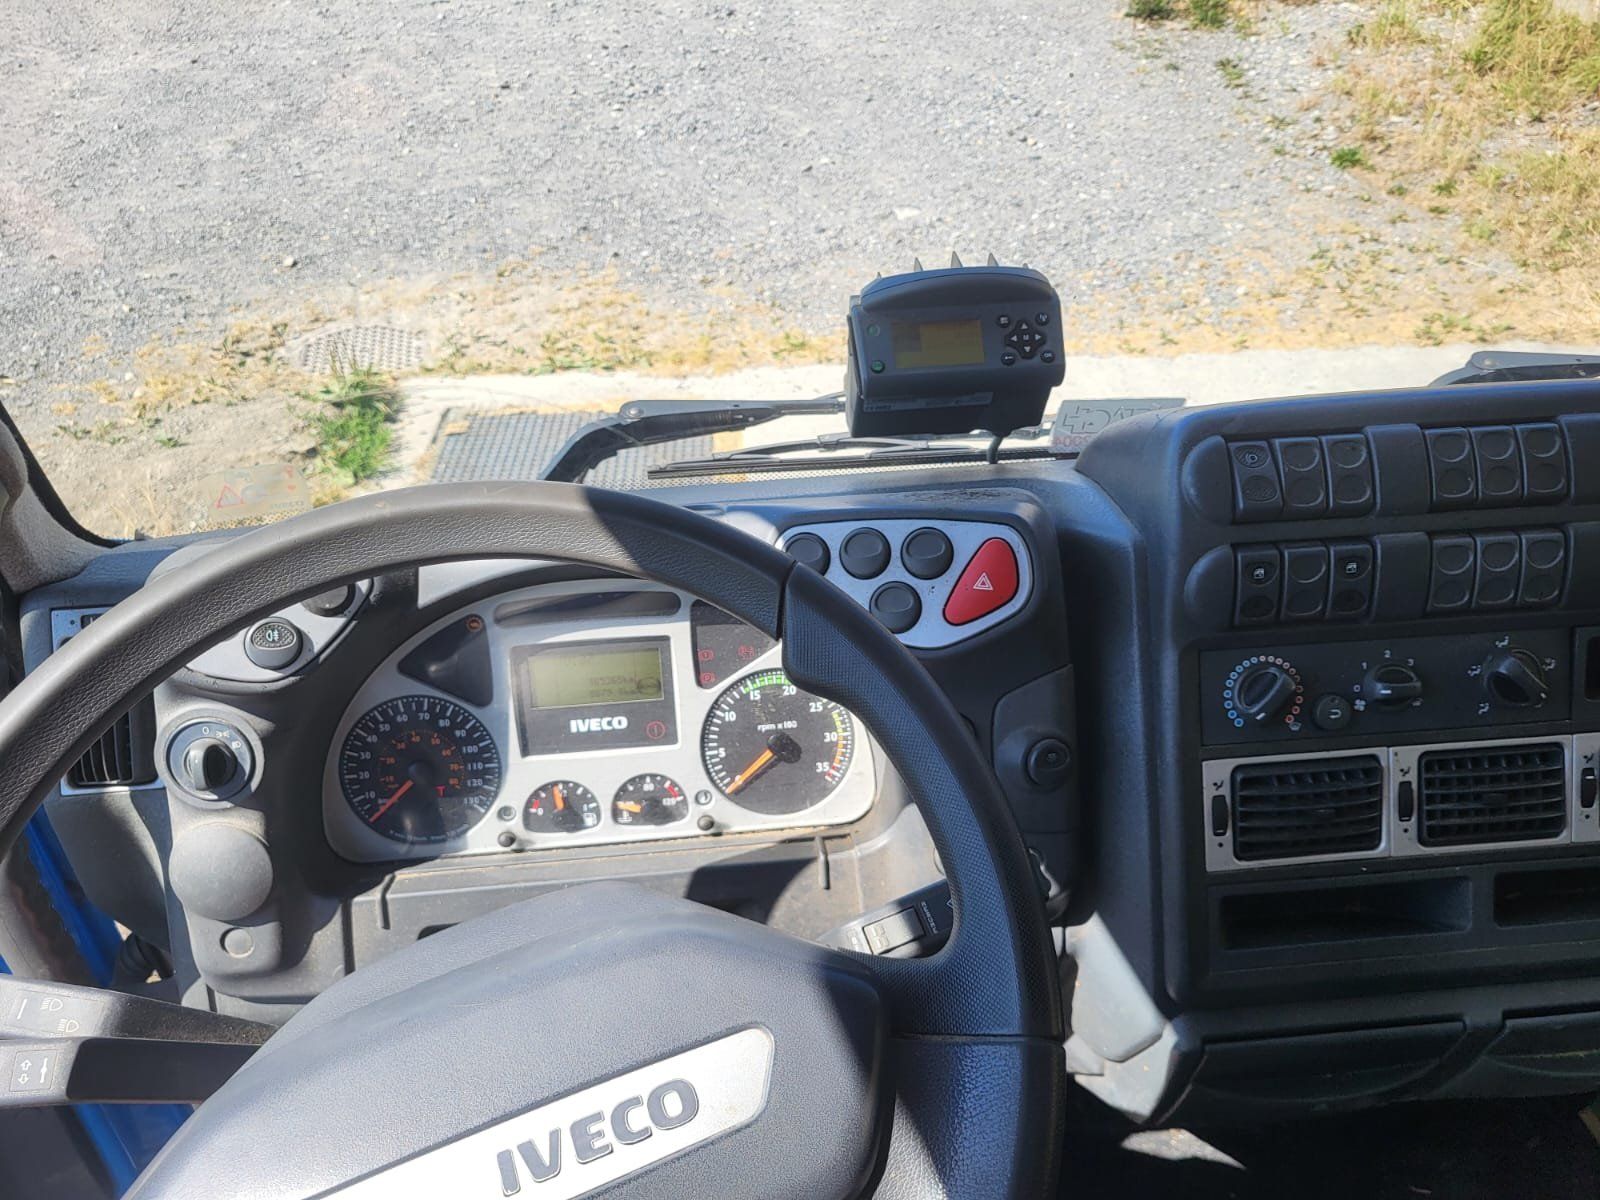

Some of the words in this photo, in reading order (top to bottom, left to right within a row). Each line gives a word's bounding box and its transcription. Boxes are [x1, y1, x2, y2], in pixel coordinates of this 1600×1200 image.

[750, 690, 760, 700] 15
[783, 686, 796, 695] 20
[809, 702, 823, 712] 25
[396, 714, 408, 722] 60
[724, 712, 736, 721] 10
[379, 724, 390, 732] 50
[570, 716, 628, 733] IVECO
[757, 722, 776, 732] rpm
[366, 735, 378, 743] 40
[824, 732, 837, 742] 30
[462, 746, 478, 754] 100
[719, 748, 726, 757] 5
[467, 762, 483, 770] 110
[816, 762, 830, 772] 35
[358, 772, 370, 780] 20
[364, 790, 376, 799] 10
[497, 1078, 699, 1197] IVECO
